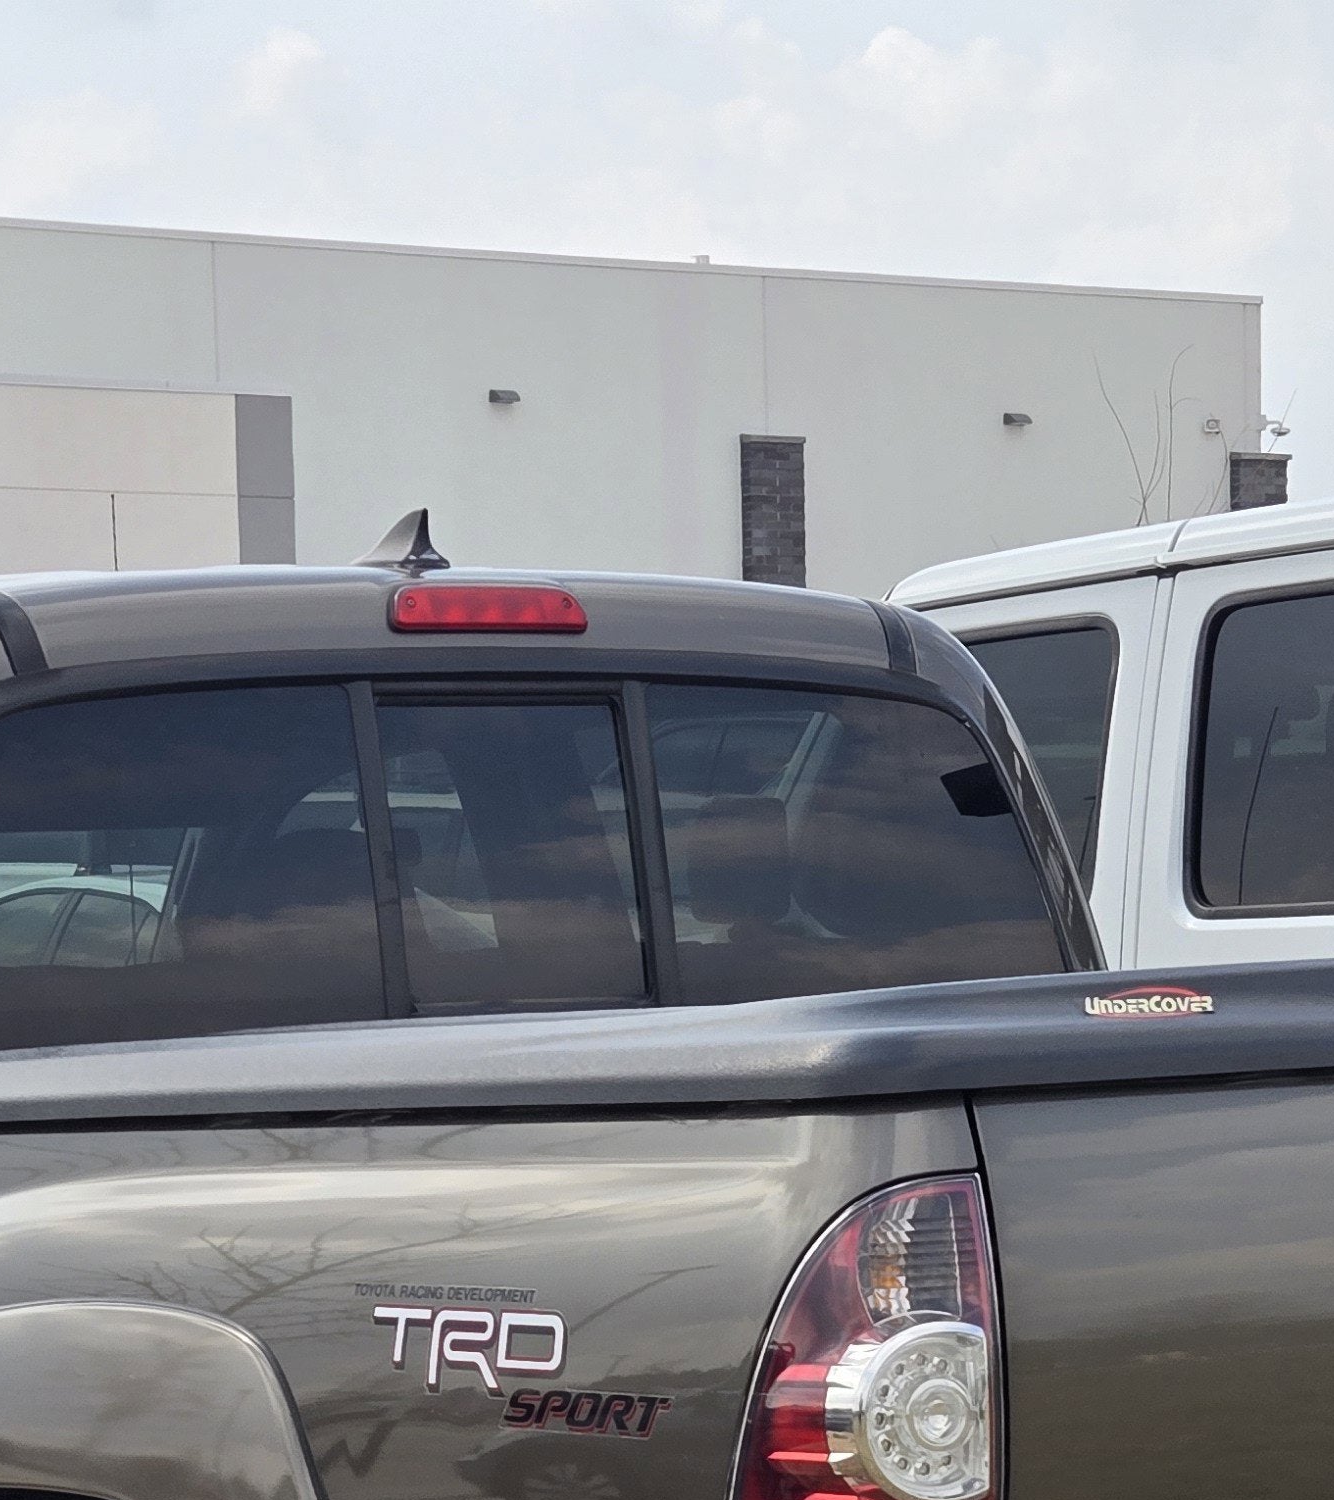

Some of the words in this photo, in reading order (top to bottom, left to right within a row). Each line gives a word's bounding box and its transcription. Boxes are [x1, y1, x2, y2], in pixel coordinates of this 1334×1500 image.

[354, 1283, 395, 1298] TOYOTA
[399, 1285, 443, 1300] RACING
[447, 1286, 536, 1303] DEVELOPMENT
[373, 1304, 567, 1395] TRD
[503, 1388, 673, 1439] SPORT
